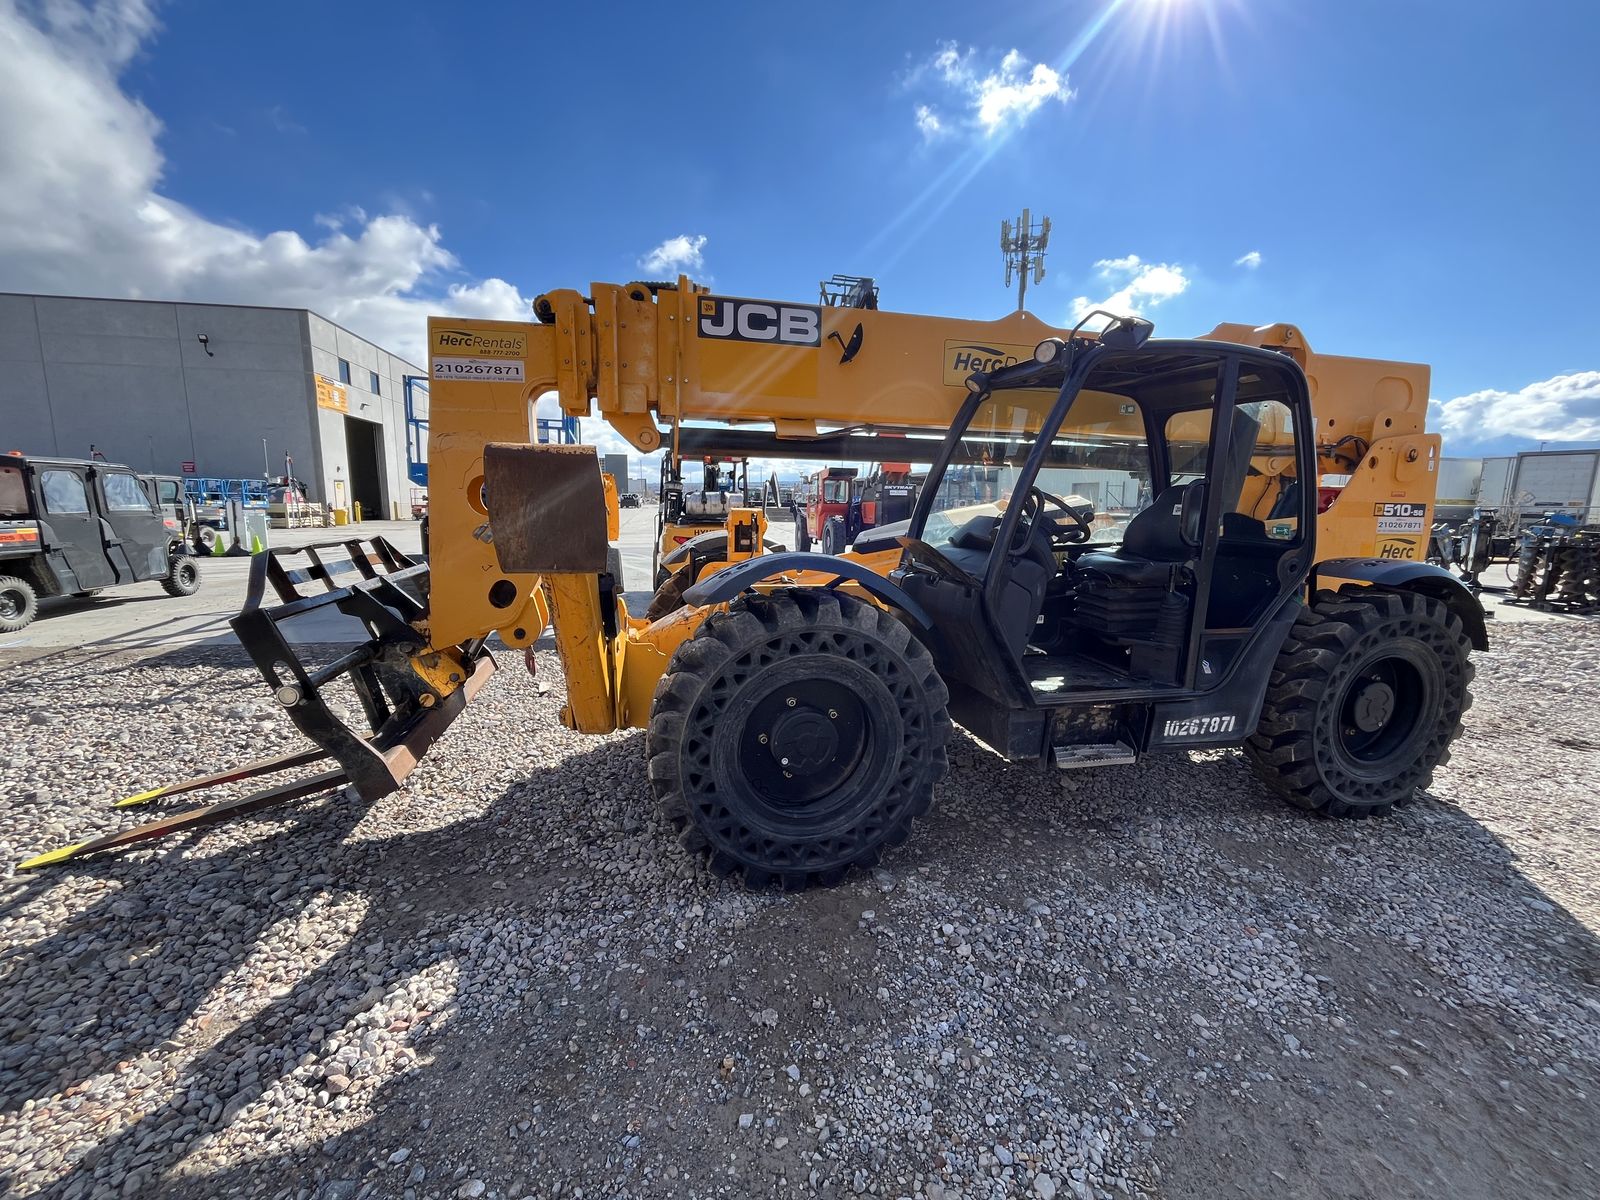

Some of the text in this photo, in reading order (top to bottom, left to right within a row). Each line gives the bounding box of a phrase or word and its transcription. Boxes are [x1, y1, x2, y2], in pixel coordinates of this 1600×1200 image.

[701, 302, 818, 342] JCB
[440, 335, 522, 350] HercRentals
[435, 364, 520, 375] 210267871
[1378, 521, 1421, 529] 210267871
[1380, 544, 1415, 559] Herc
[1164, 715, 1236, 737] 10267871
